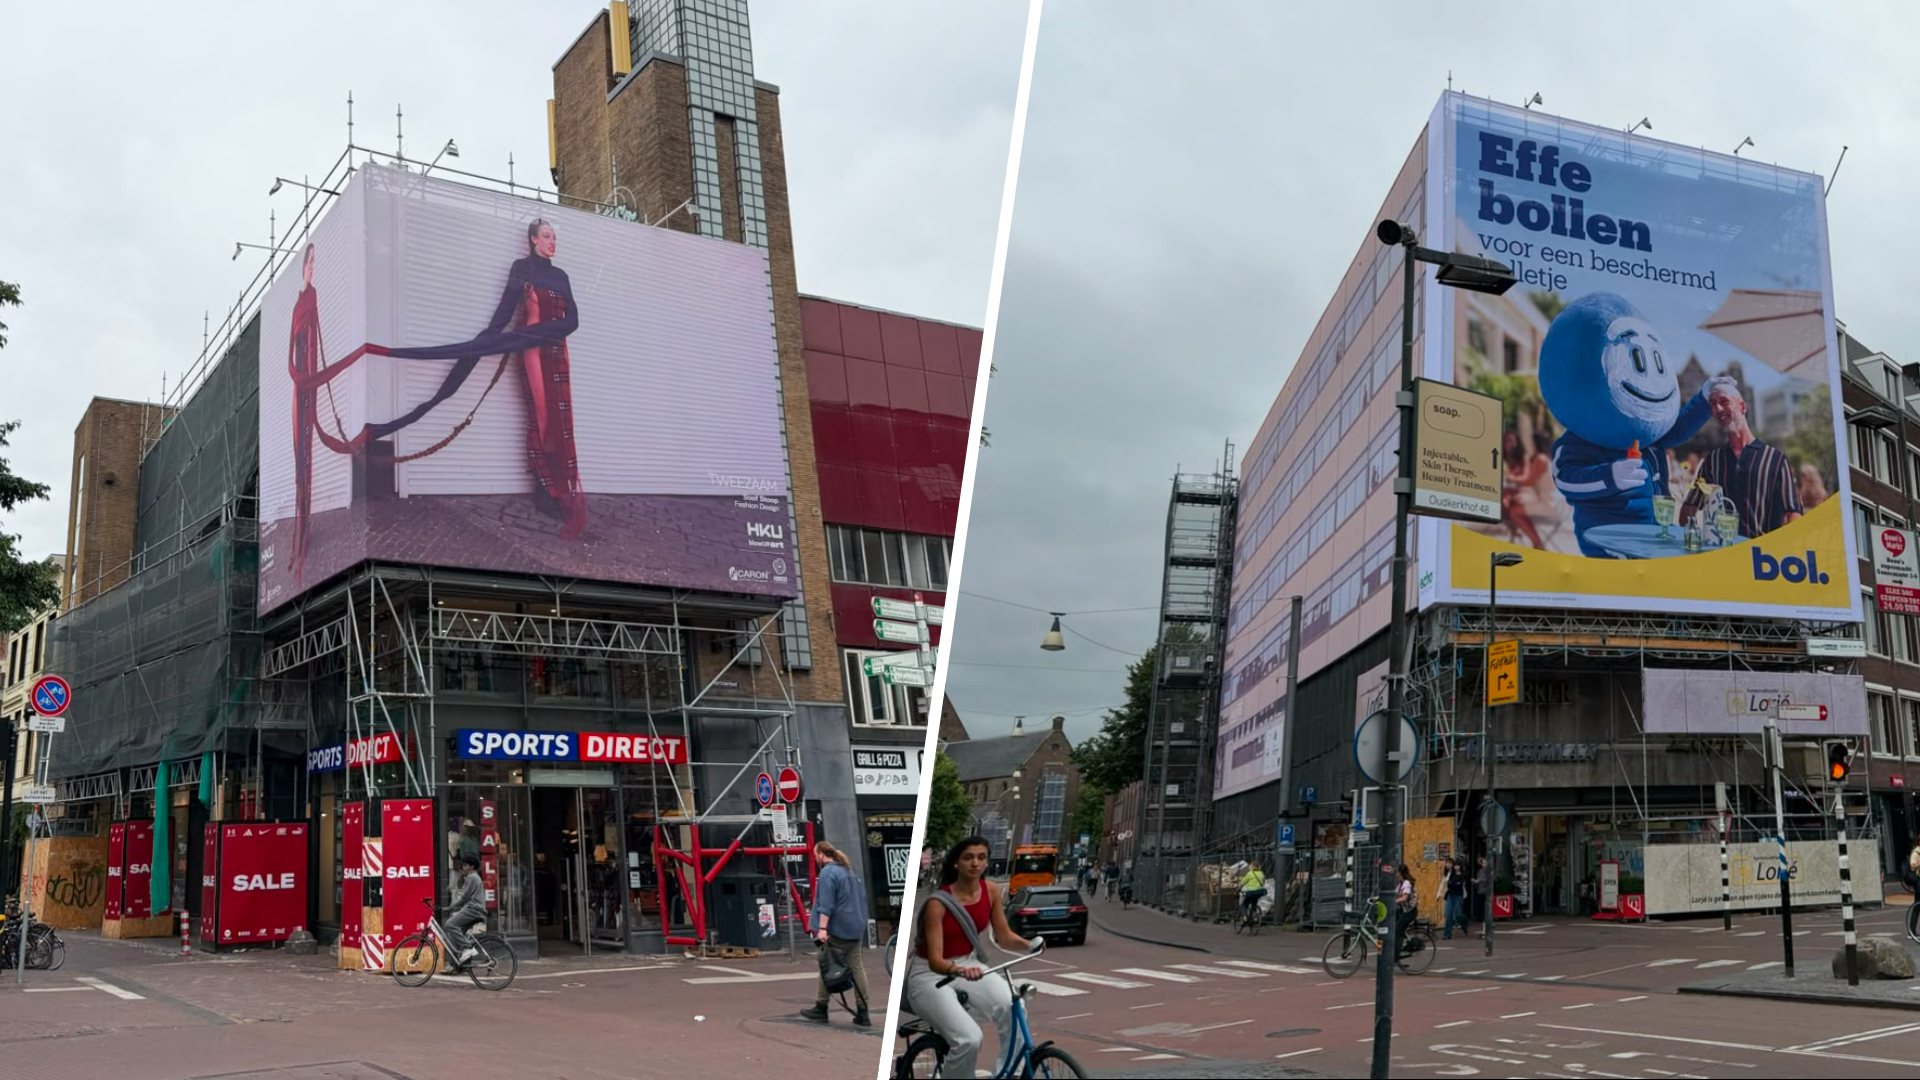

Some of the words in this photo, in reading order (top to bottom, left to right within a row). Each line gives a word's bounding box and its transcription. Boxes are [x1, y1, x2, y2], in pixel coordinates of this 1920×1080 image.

[1479, 131, 1592, 193] Effe
[1478, 178, 1652, 253] bollen
[1478, 233, 1533, 258] voor
[1540, 246, 1584, 268] een
[1590, 250, 1717, 290] beschermd
[1478, 254, 1567, 292] lletje
[1433, 404, 1461, 418] soap.
[1421, 459, 1442, 471] Skin
[709, 473, 778, 491] TWEEZAAM
[1421, 471, 1452, 486] Beauty
[734, 500, 759, 510] Fashion
[760, 503, 780, 513] Design
[1428, 494, 1478, 512] Oudkerkhof
[1479, 505, 1490, 515] 48
[747, 521, 783, 540] HKU
[1752, 546, 1829, 585] bol.
[468, 732, 569, 757] SPORTS
[587, 736, 681, 760] DIRECT
[307, 745, 342, 770] SPORTS
[857, 753, 876, 765] GRILL
[883, 754, 902, 766] PIZZA
[1282, 826, 1291, 838] P
[483, 807, 496, 902] SALE
[129, 863, 150, 874] SA
[343, 867, 361, 879] SALE
[386, 866, 429, 879] SALE
[232, 872, 295, 892] SALE
[1604, 878, 1617, 886] OPEN
